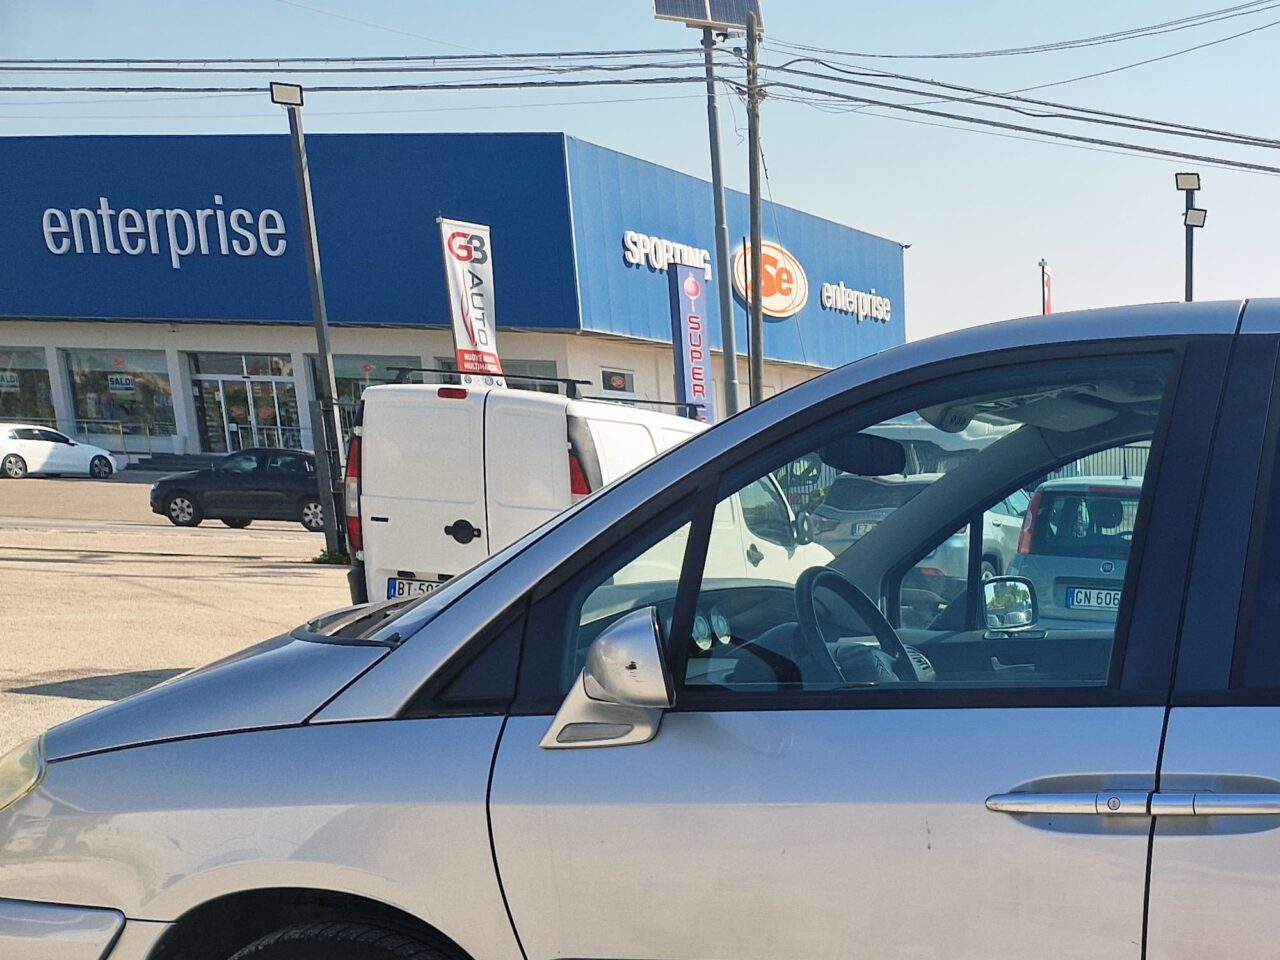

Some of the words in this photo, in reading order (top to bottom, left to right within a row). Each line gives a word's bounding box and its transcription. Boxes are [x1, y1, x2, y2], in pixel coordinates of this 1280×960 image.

[42, 194, 287, 269] enterprise
[447, 231, 488, 265] GB
[624, 230, 712, 281] SPORTING
[467, 269, 488, 346] AUTO
[821, 280, 891, 321] enterprise
[688, 315, 706, 400] SUPER
[397, 581, 413, 596] BT
